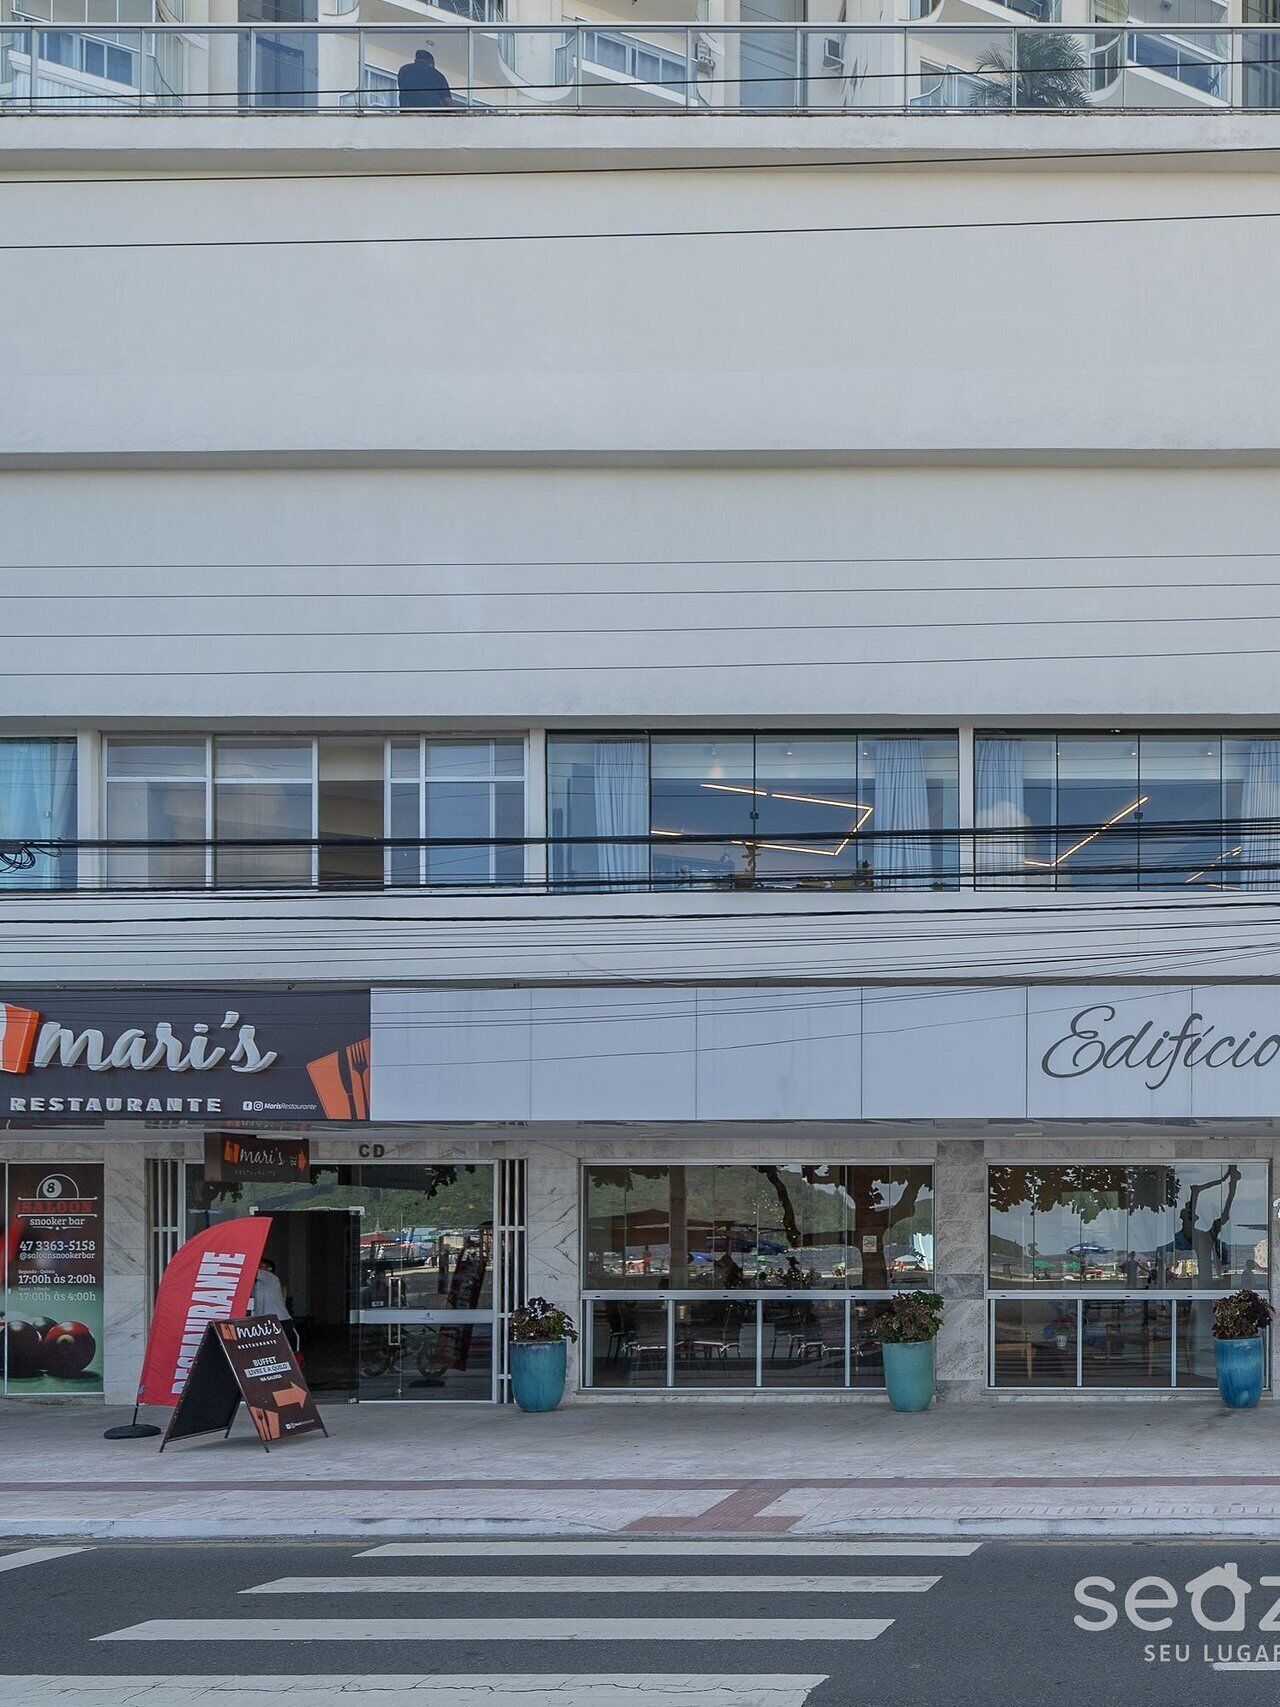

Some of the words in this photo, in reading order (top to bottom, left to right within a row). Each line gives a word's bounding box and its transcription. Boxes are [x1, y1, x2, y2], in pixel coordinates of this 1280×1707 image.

[34, 1011, 278, 1073] mari's
[10, 1097, 222, 1113] RESTAURANTE
[239, 1147, 286, 1166] mari's
[358, 1143, 386, 1158] CD
[21, 1200, 92, 1213] SALOON
[29, 1216, 67, 1225] snooker
[69, 1216, 85, 1225] bar
[20, 1240, 33, 1251] 47
[35, 1240, 96, 1251] 3363-5158
[19, 1251, 95, 1260] @saloonsnookerbar
[18, 1274, 51, 1284] 17:00h
[53, 1273, 66, 1284] às
[67, 1274, 96, 1284] 2:00h
[19, 1291, 51, 1301] 17:00h
[53, 1291, 66, 1301] às
[67, 1291, 96, 1301] 4:00h
[236, 1319, 281, 1339] mari's
[252, 1356, 277, 1367] BUFFET
